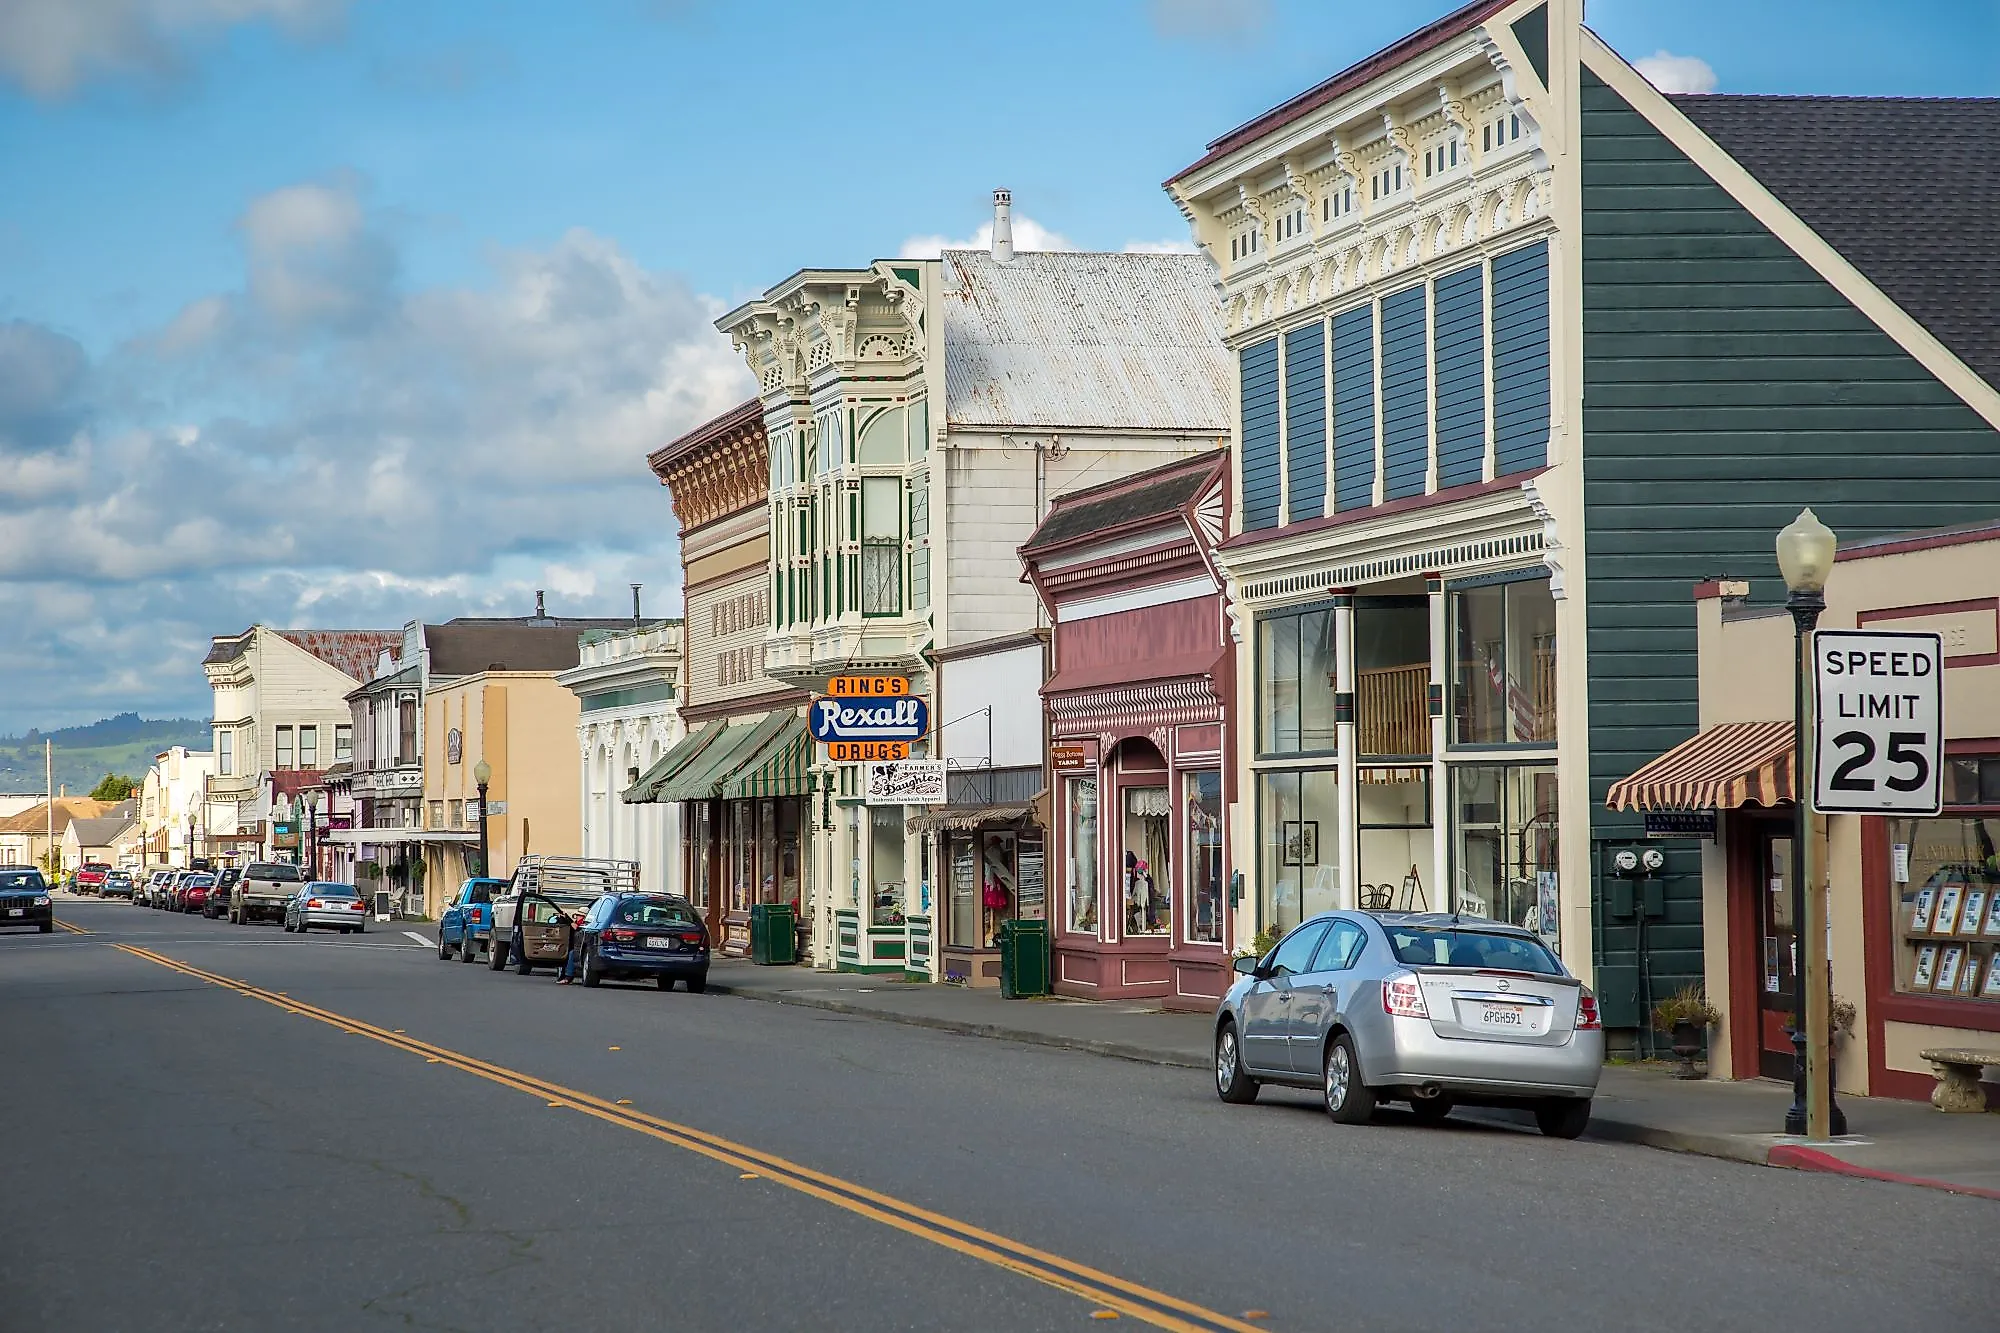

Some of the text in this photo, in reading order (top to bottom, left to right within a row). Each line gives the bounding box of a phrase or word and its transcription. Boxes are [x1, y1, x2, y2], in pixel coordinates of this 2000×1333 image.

[1826, 651, 1931, 676] SPEED
[836, 678, 901, 694] RING'S
[1839, 693, 1920, 719] LIMIT
[818, 700, 919, 737] Rexall
[837, 743, 901, 759] DRUGS
[1830, 731, 1929, 792] 25
[883, 773, 941, 797] Daughter
[1648, 815, 1710, 823] LANDMARK
[1484, 1010, 1522, 1024] 6PGH591
